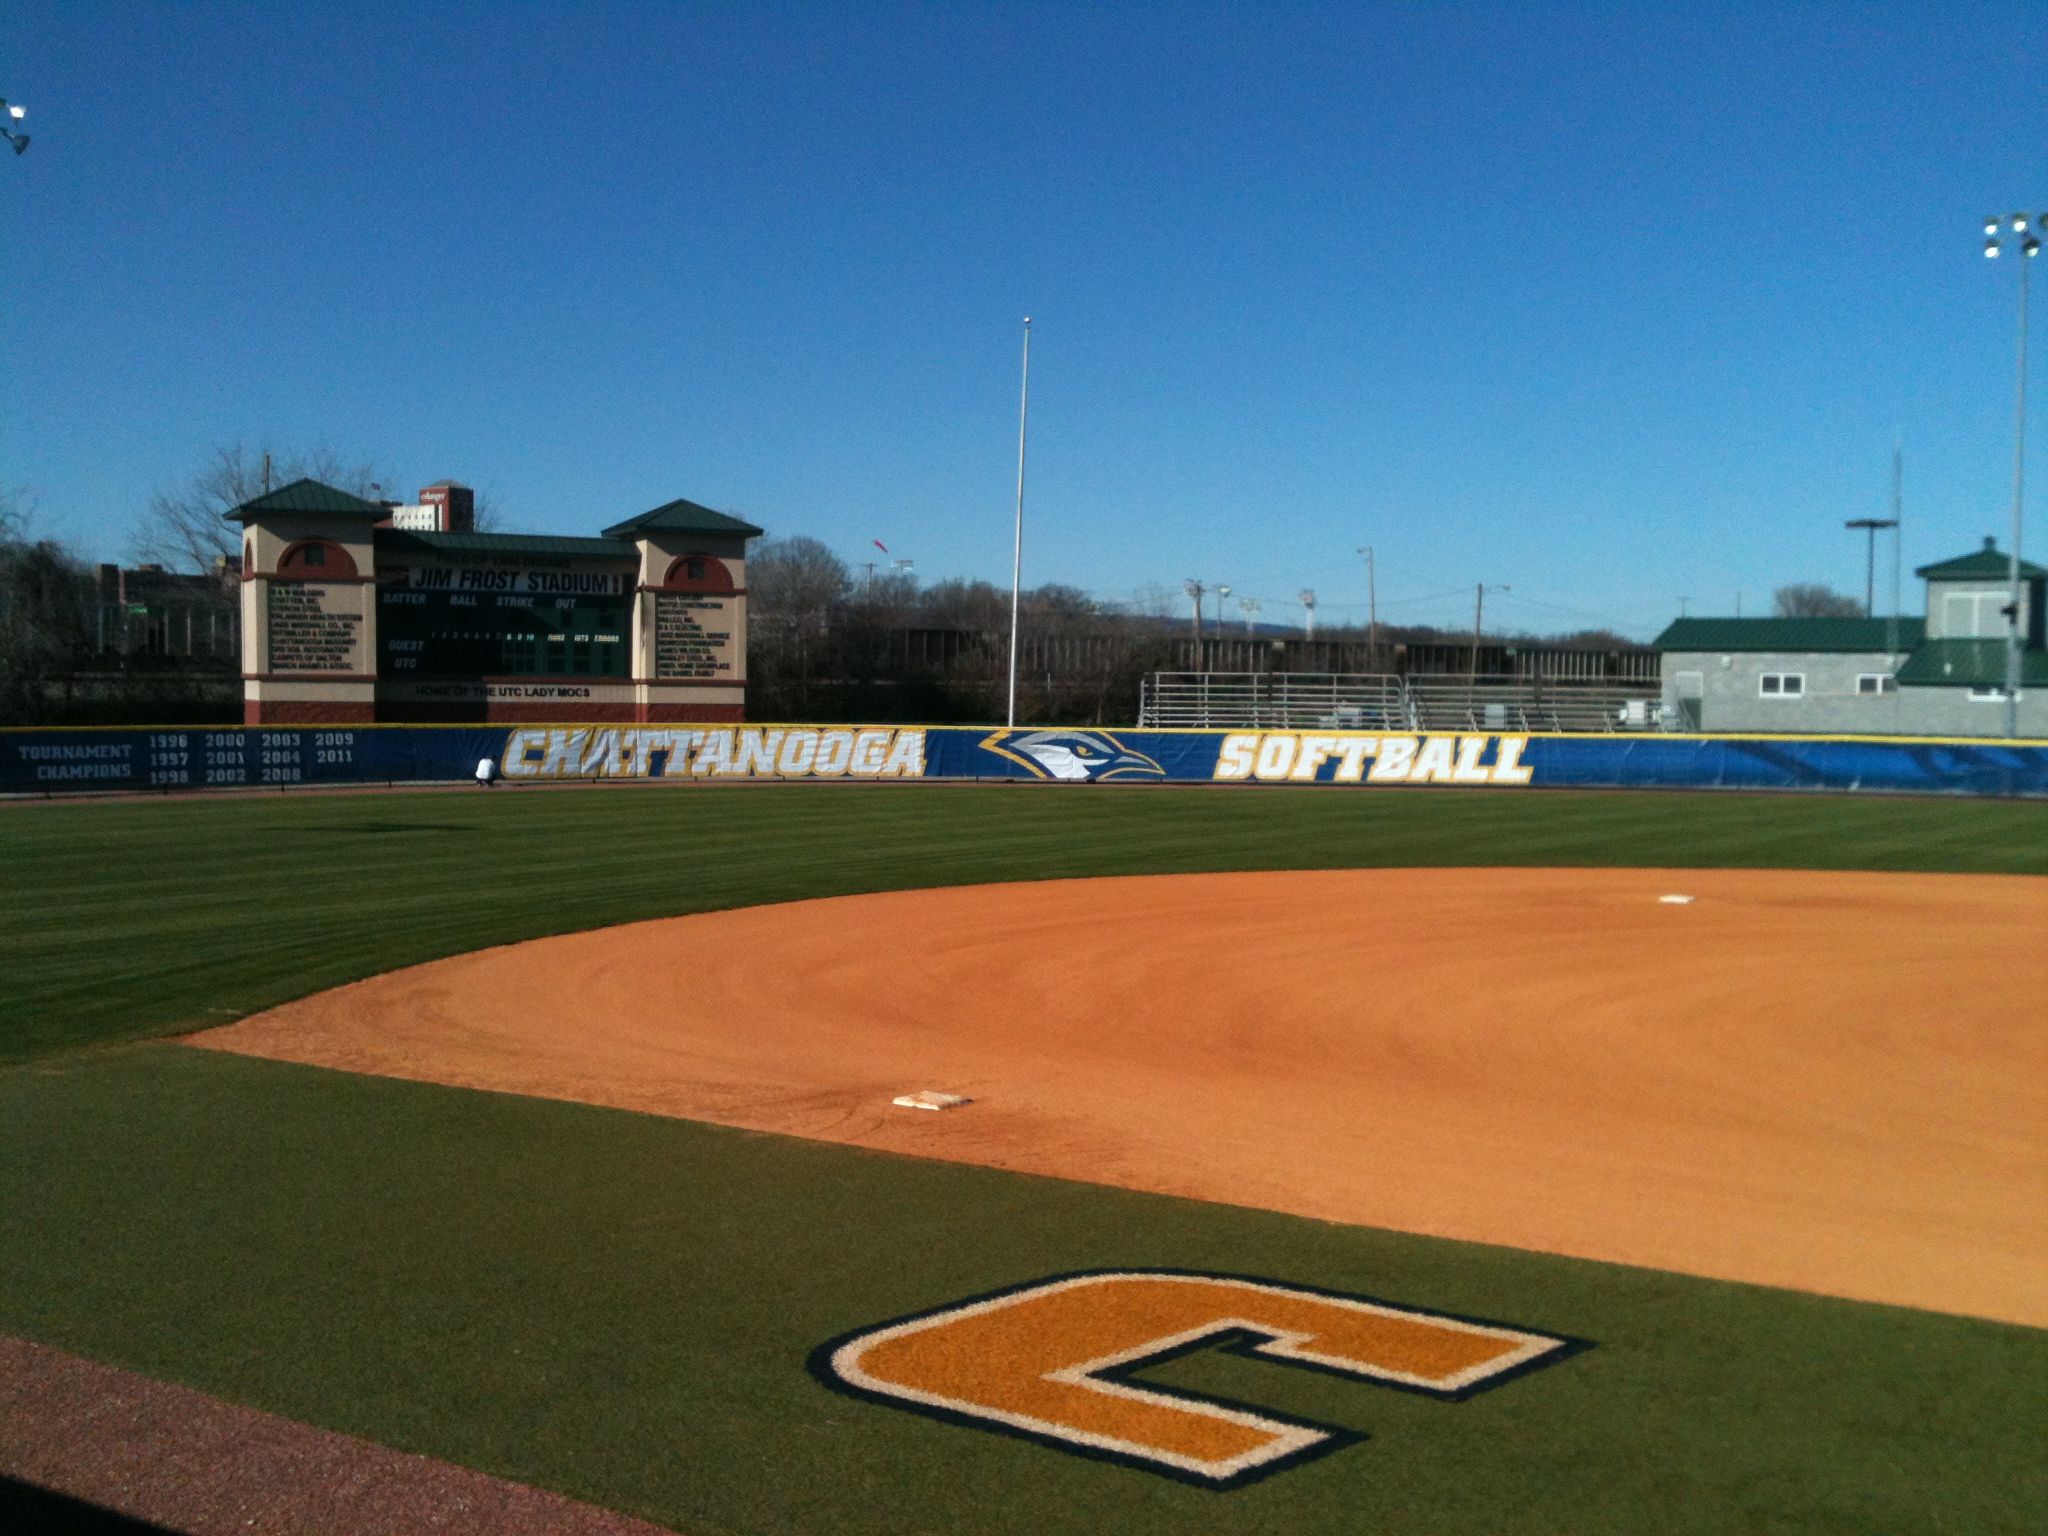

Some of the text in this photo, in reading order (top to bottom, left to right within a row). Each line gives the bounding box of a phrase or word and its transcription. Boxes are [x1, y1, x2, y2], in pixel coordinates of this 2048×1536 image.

[415, 568, 452, 588] JIM
[460, 569, 520, 590] FROST
[528, 572, 609, 593] STADIUM
[383, 592, 577, 609] BATTER BALL STRIKE OUT
[388, 640, 425, 652] GUEST
[394, 658, 417, 669] UTC
[416, 685, 590, 698] HOME OF THE UTC LADY MOCS
[149, 732, 354, 749] 1996 2000 2003 2009
[18, 743, 133, 761] TOURNAMENT
[150, 749, 352, 767] 1997 2001 2004 2011
[500, 728, 927, 779] CHATTANOOGA
[1213, 732, 1533, 785] SOFTBALL
[37, 764, 131, 780] CHAMPIONS
[150, 770, 189, 785] 1998
[206, 768, 246, 782] 2002
[806, 1268, 1598, 1492] C
